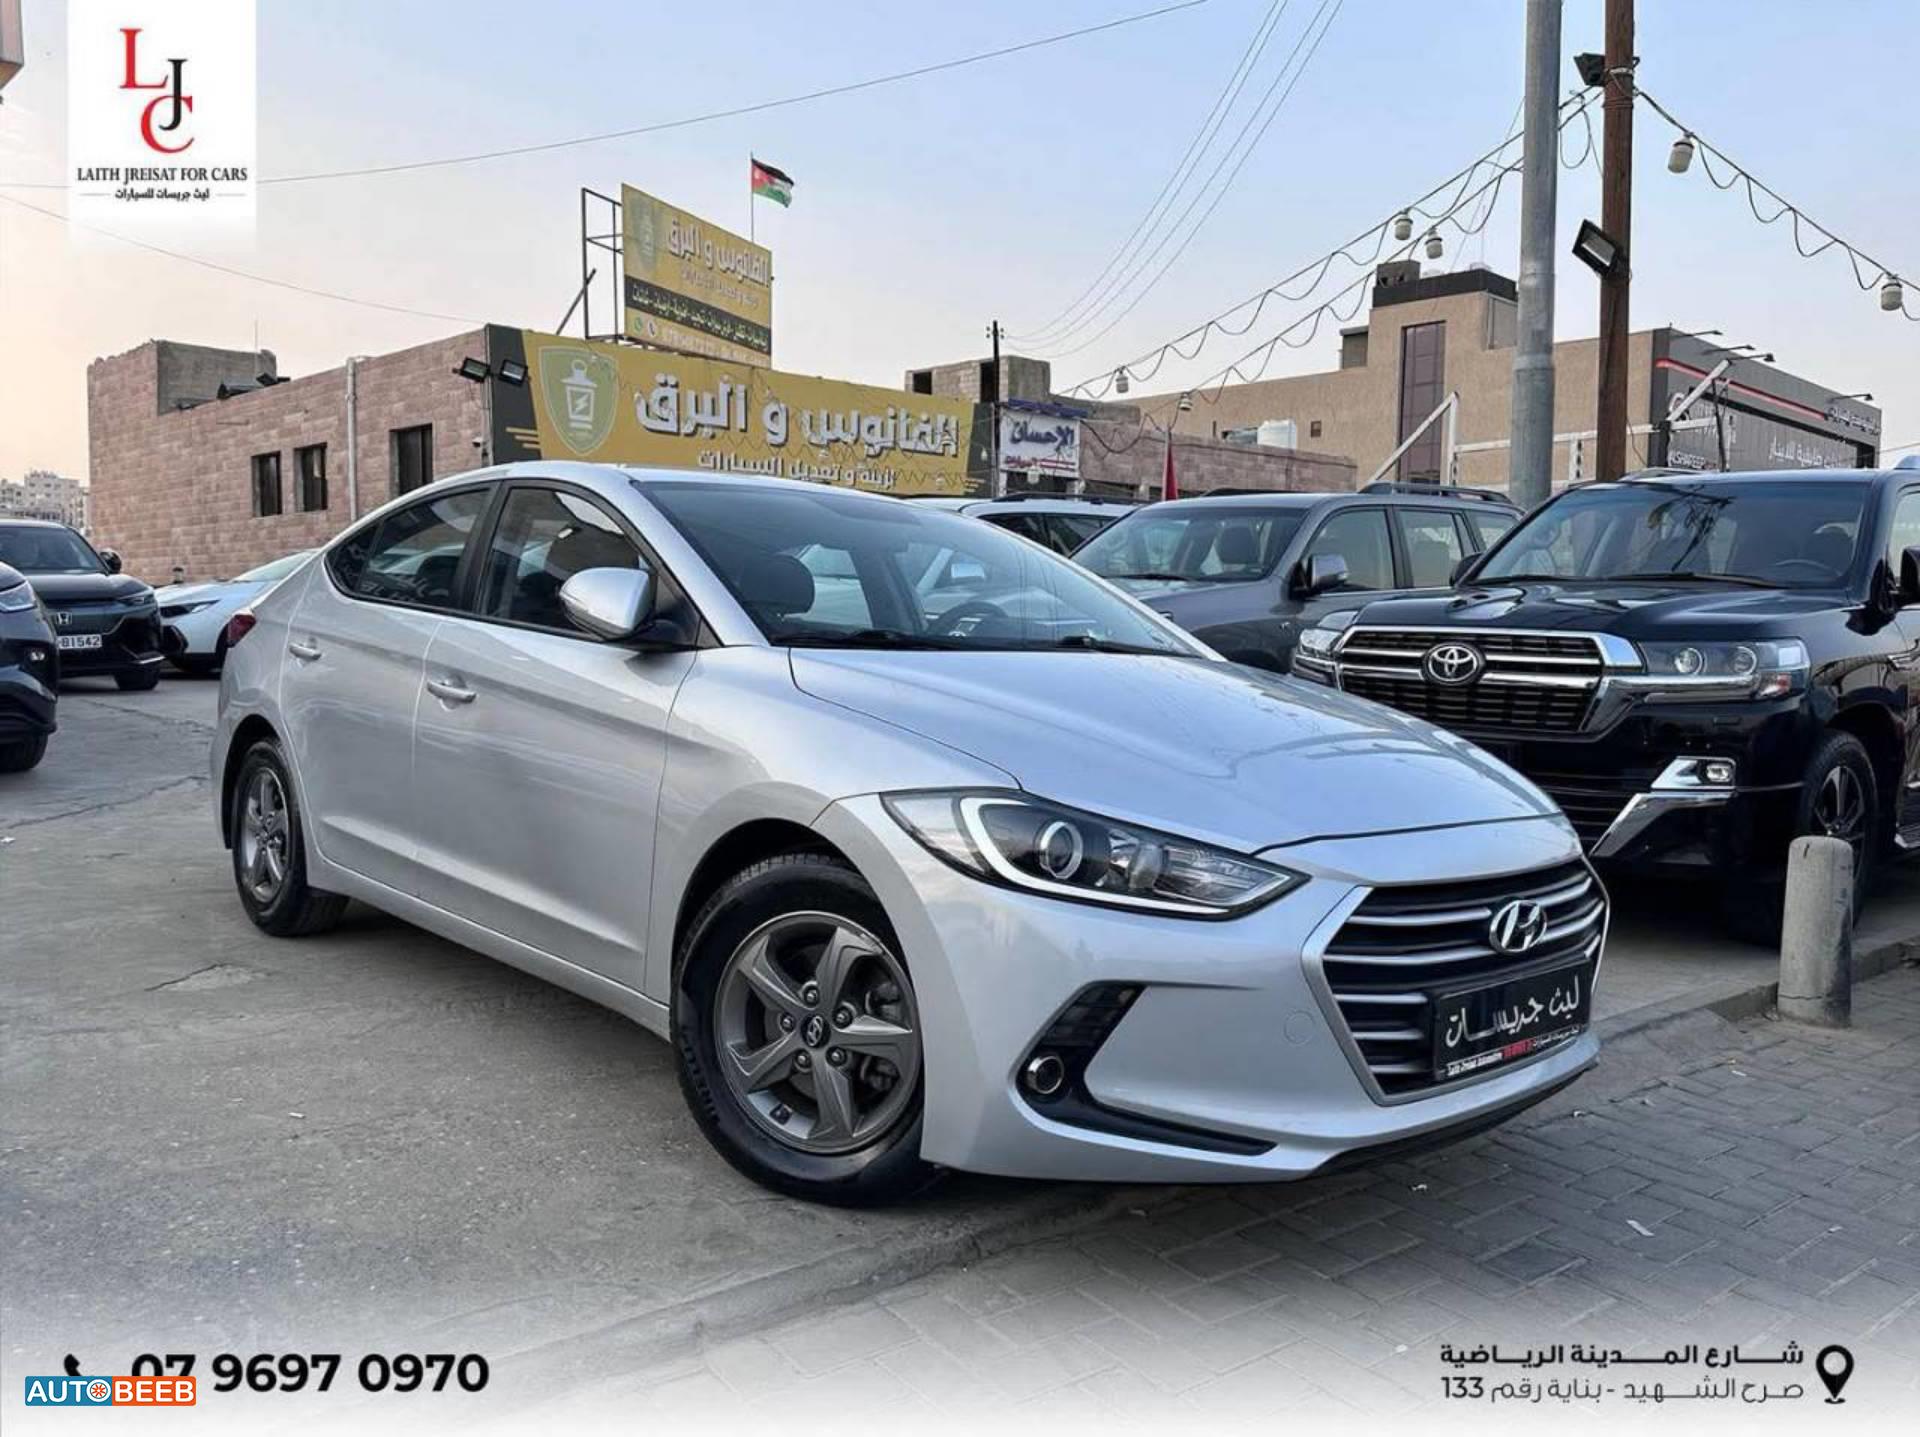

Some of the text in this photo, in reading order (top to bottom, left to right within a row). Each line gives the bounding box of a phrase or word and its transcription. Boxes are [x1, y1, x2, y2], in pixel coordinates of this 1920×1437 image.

[667, 218, 701, 262] البرق
[704, 240, 713, 271] و
[634, 372, 958, 457] الفانوس و البرق
[698, 450, 780, 476] السيارات
[1549, 975, 1580, 1019] ليث
[1445, 997, 1545, 1048] جريسات
